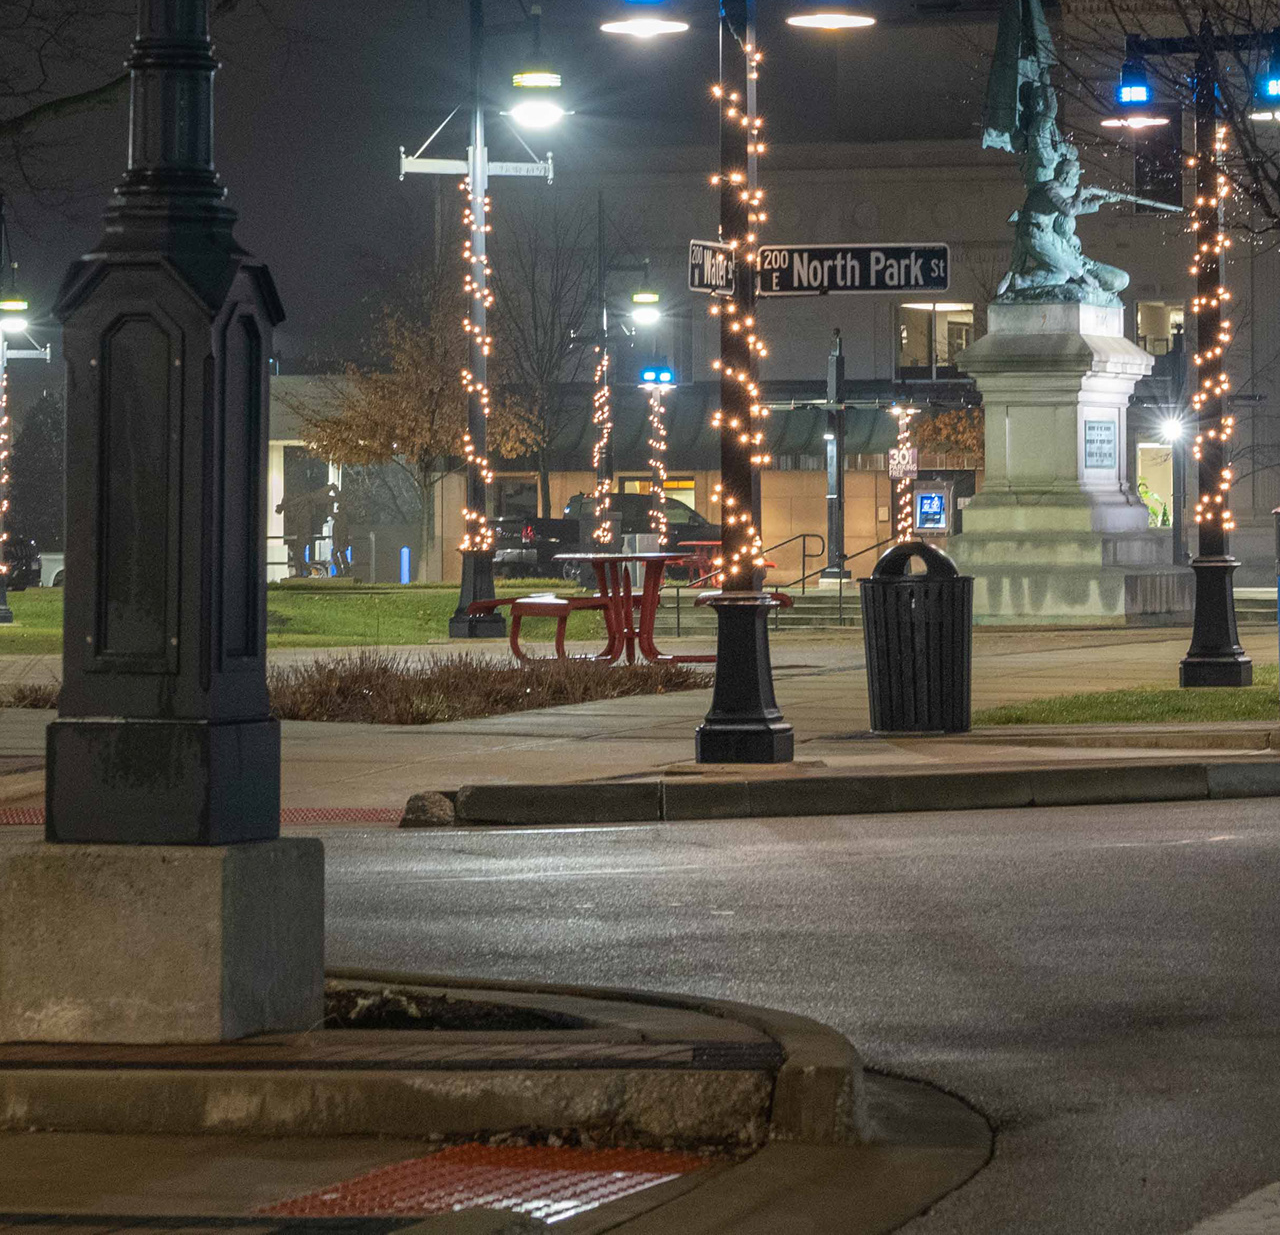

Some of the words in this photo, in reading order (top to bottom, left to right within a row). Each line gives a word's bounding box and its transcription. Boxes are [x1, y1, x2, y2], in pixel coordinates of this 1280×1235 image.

[691, 245, 703, 264] 200
[763, 250, 789, 270] 200
[704, 249, 727, 286] Water
[793, 251, 860, 288] North
[869, 250, 925, 287] Park
[930, 259, 945, 278] St
[771, 272, 780, 291] E
